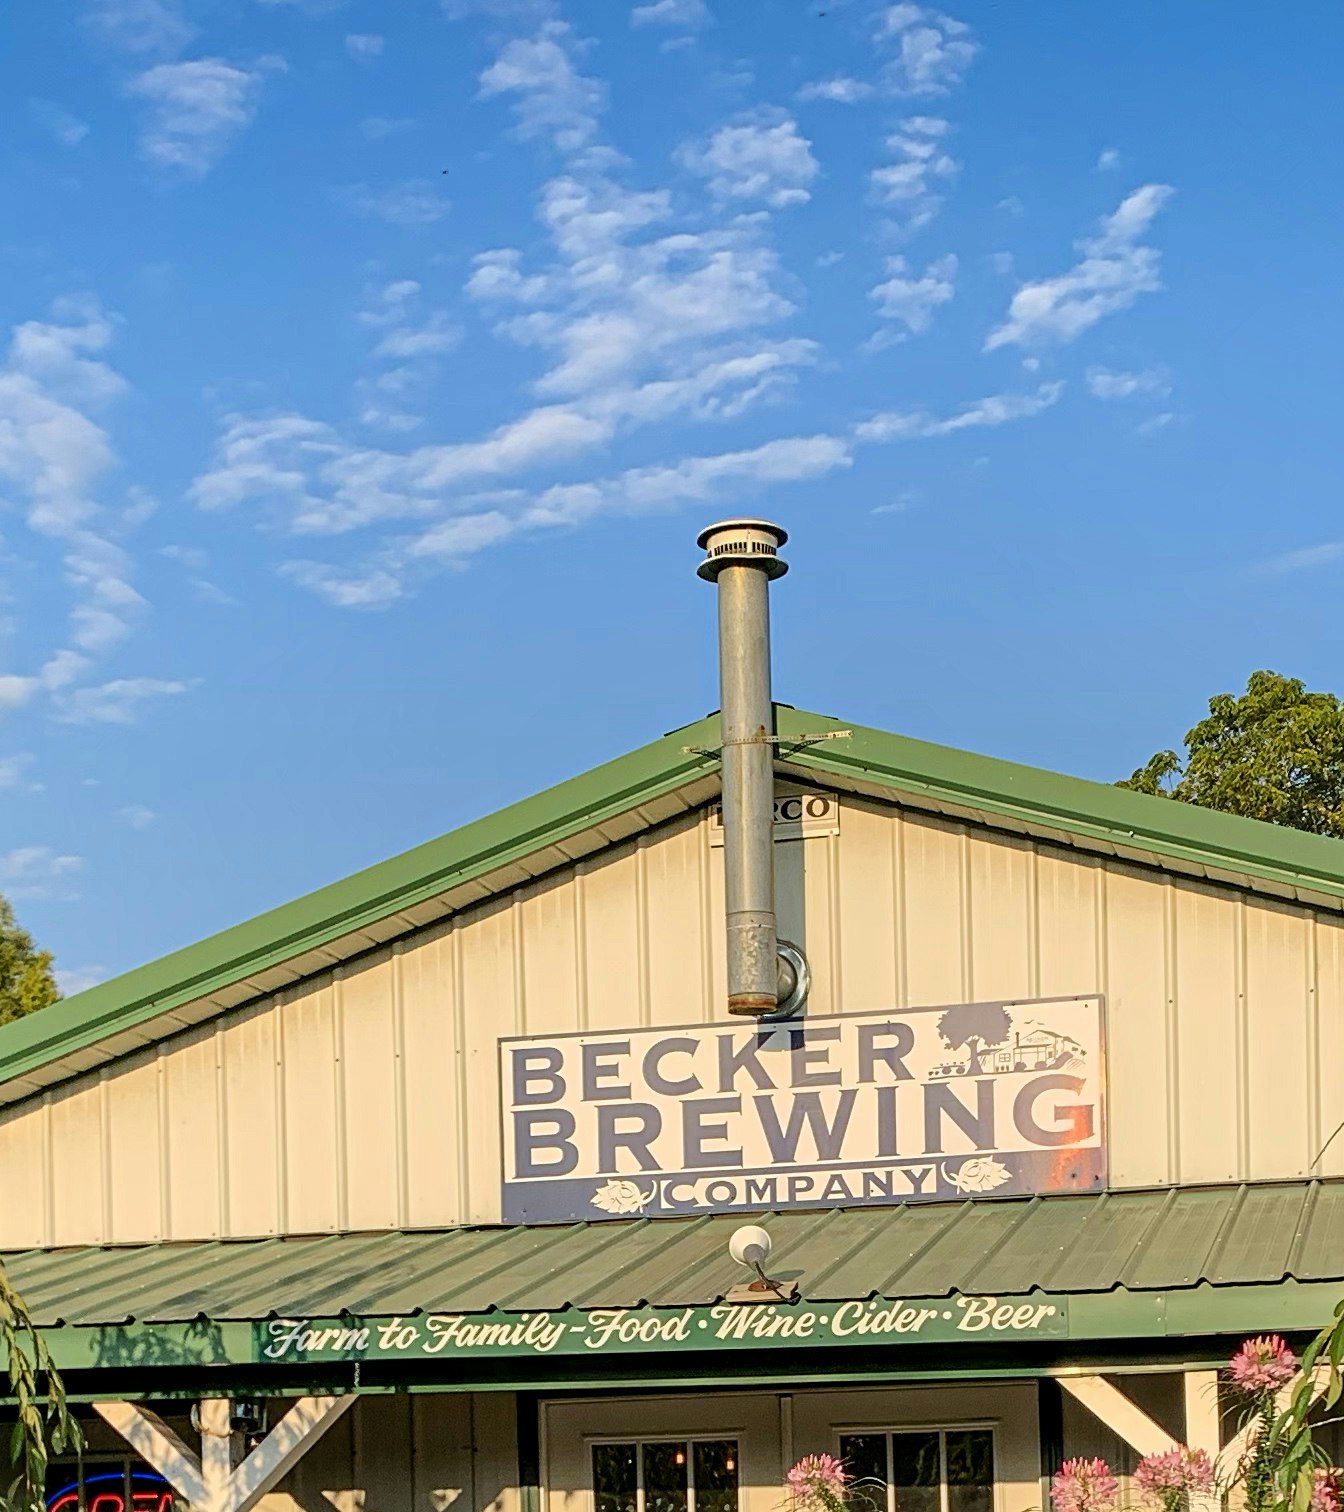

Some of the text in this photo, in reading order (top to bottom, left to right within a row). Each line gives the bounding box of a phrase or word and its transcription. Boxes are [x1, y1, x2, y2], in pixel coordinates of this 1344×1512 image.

[512, 1022, 915, 1107] BECKER
[513, 1074, 1096, 1179] BREWING
[663, 1166, 932, 1208] COMPANY
[264, 1319, 369, 1357] Farm
[378, 1317, 419, 1350] to
[957, 1296, 1055, 1332] Beer
